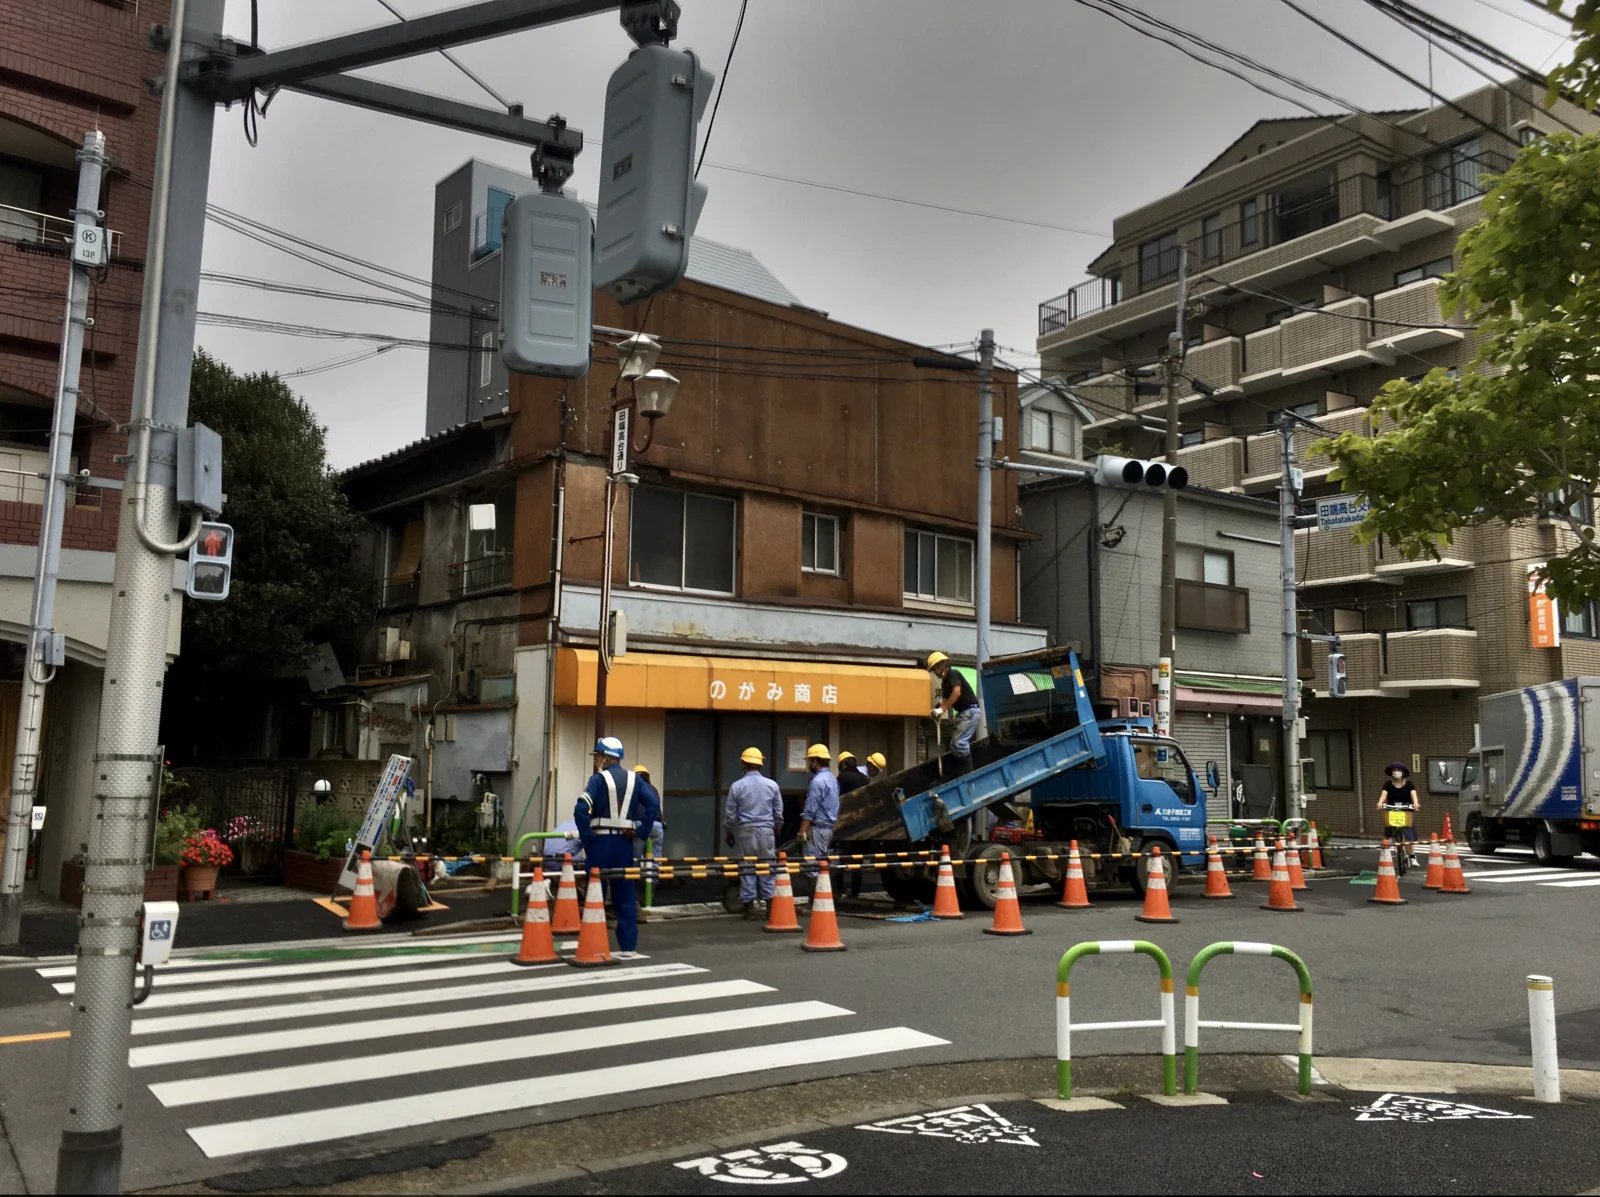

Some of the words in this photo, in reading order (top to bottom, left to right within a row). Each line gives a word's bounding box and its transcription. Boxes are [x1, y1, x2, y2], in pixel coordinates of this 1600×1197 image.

[82, 249, 95, 259] 13P
[616, 411, 626, 471] 田端高台通り
[709, 680, 838, 705] のがみ商店
